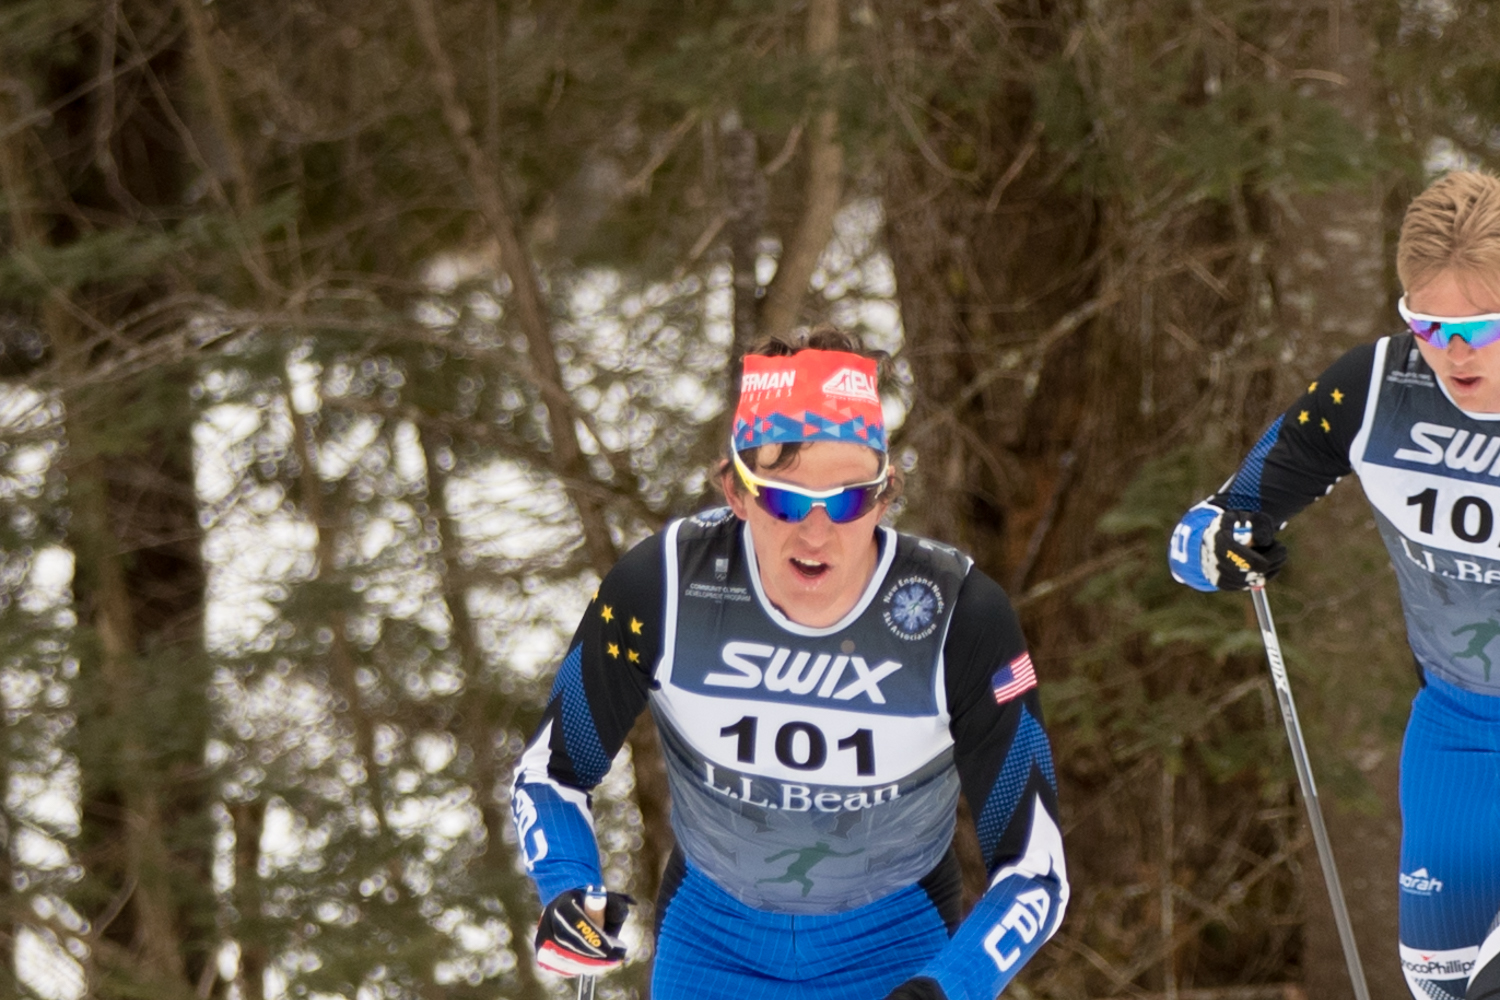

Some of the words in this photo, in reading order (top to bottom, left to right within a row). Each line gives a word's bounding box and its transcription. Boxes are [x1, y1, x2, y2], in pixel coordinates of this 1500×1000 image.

[883, 585, 899, 603] New
[898, 575, 934, 588] England
[883, 611, 894, 627] Ski
[890, 623, 938, 641] Association
[703, 641, 904, 705] SWIX
[719, 714, 877, 777] 101
[703, 760, 902, 813] L.L.Bean
[576, 919, 602, 949] TOKO
